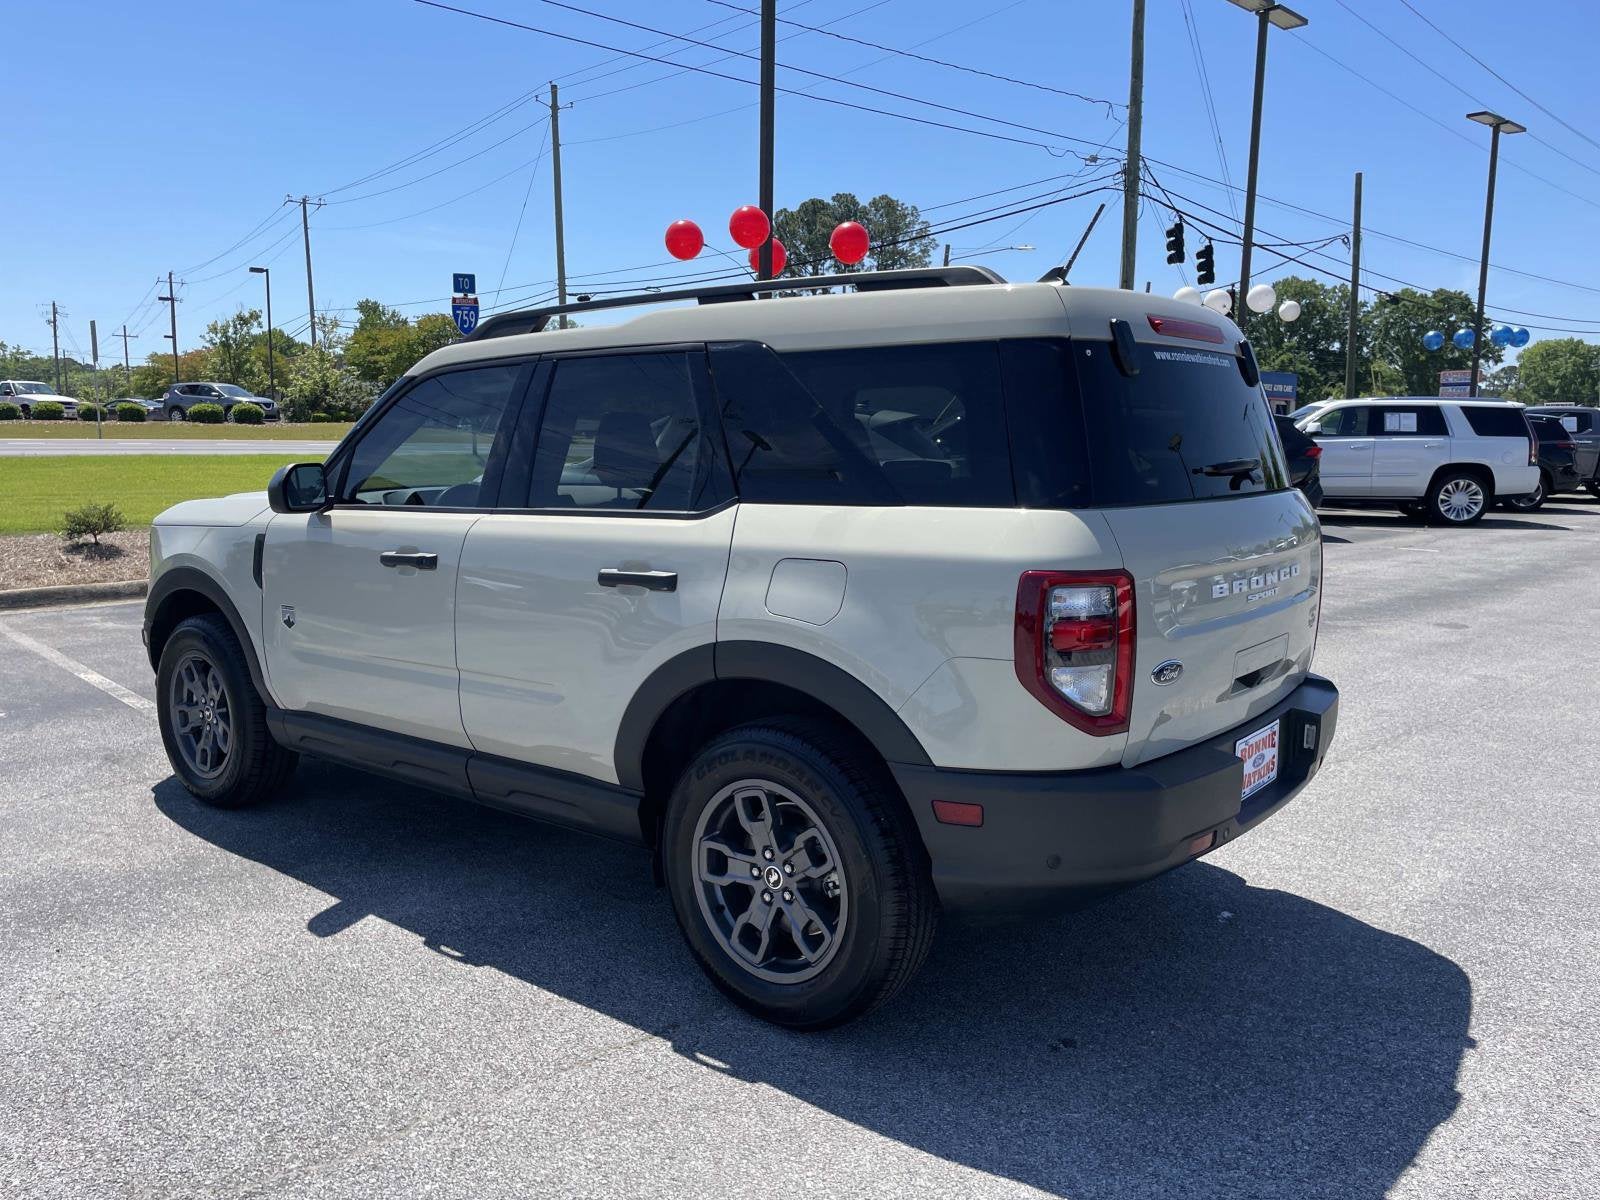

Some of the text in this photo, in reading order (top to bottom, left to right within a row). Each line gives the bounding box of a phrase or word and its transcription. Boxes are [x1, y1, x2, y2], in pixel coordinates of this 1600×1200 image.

[458, 278, 470, 289] TO
[456, 311, 475, 328] 759
[1212, 563, 1301, 599] BRONCO
[1247, 587, 1281, 602] SPORT
[1160, 663, 1180, 681] Ford
